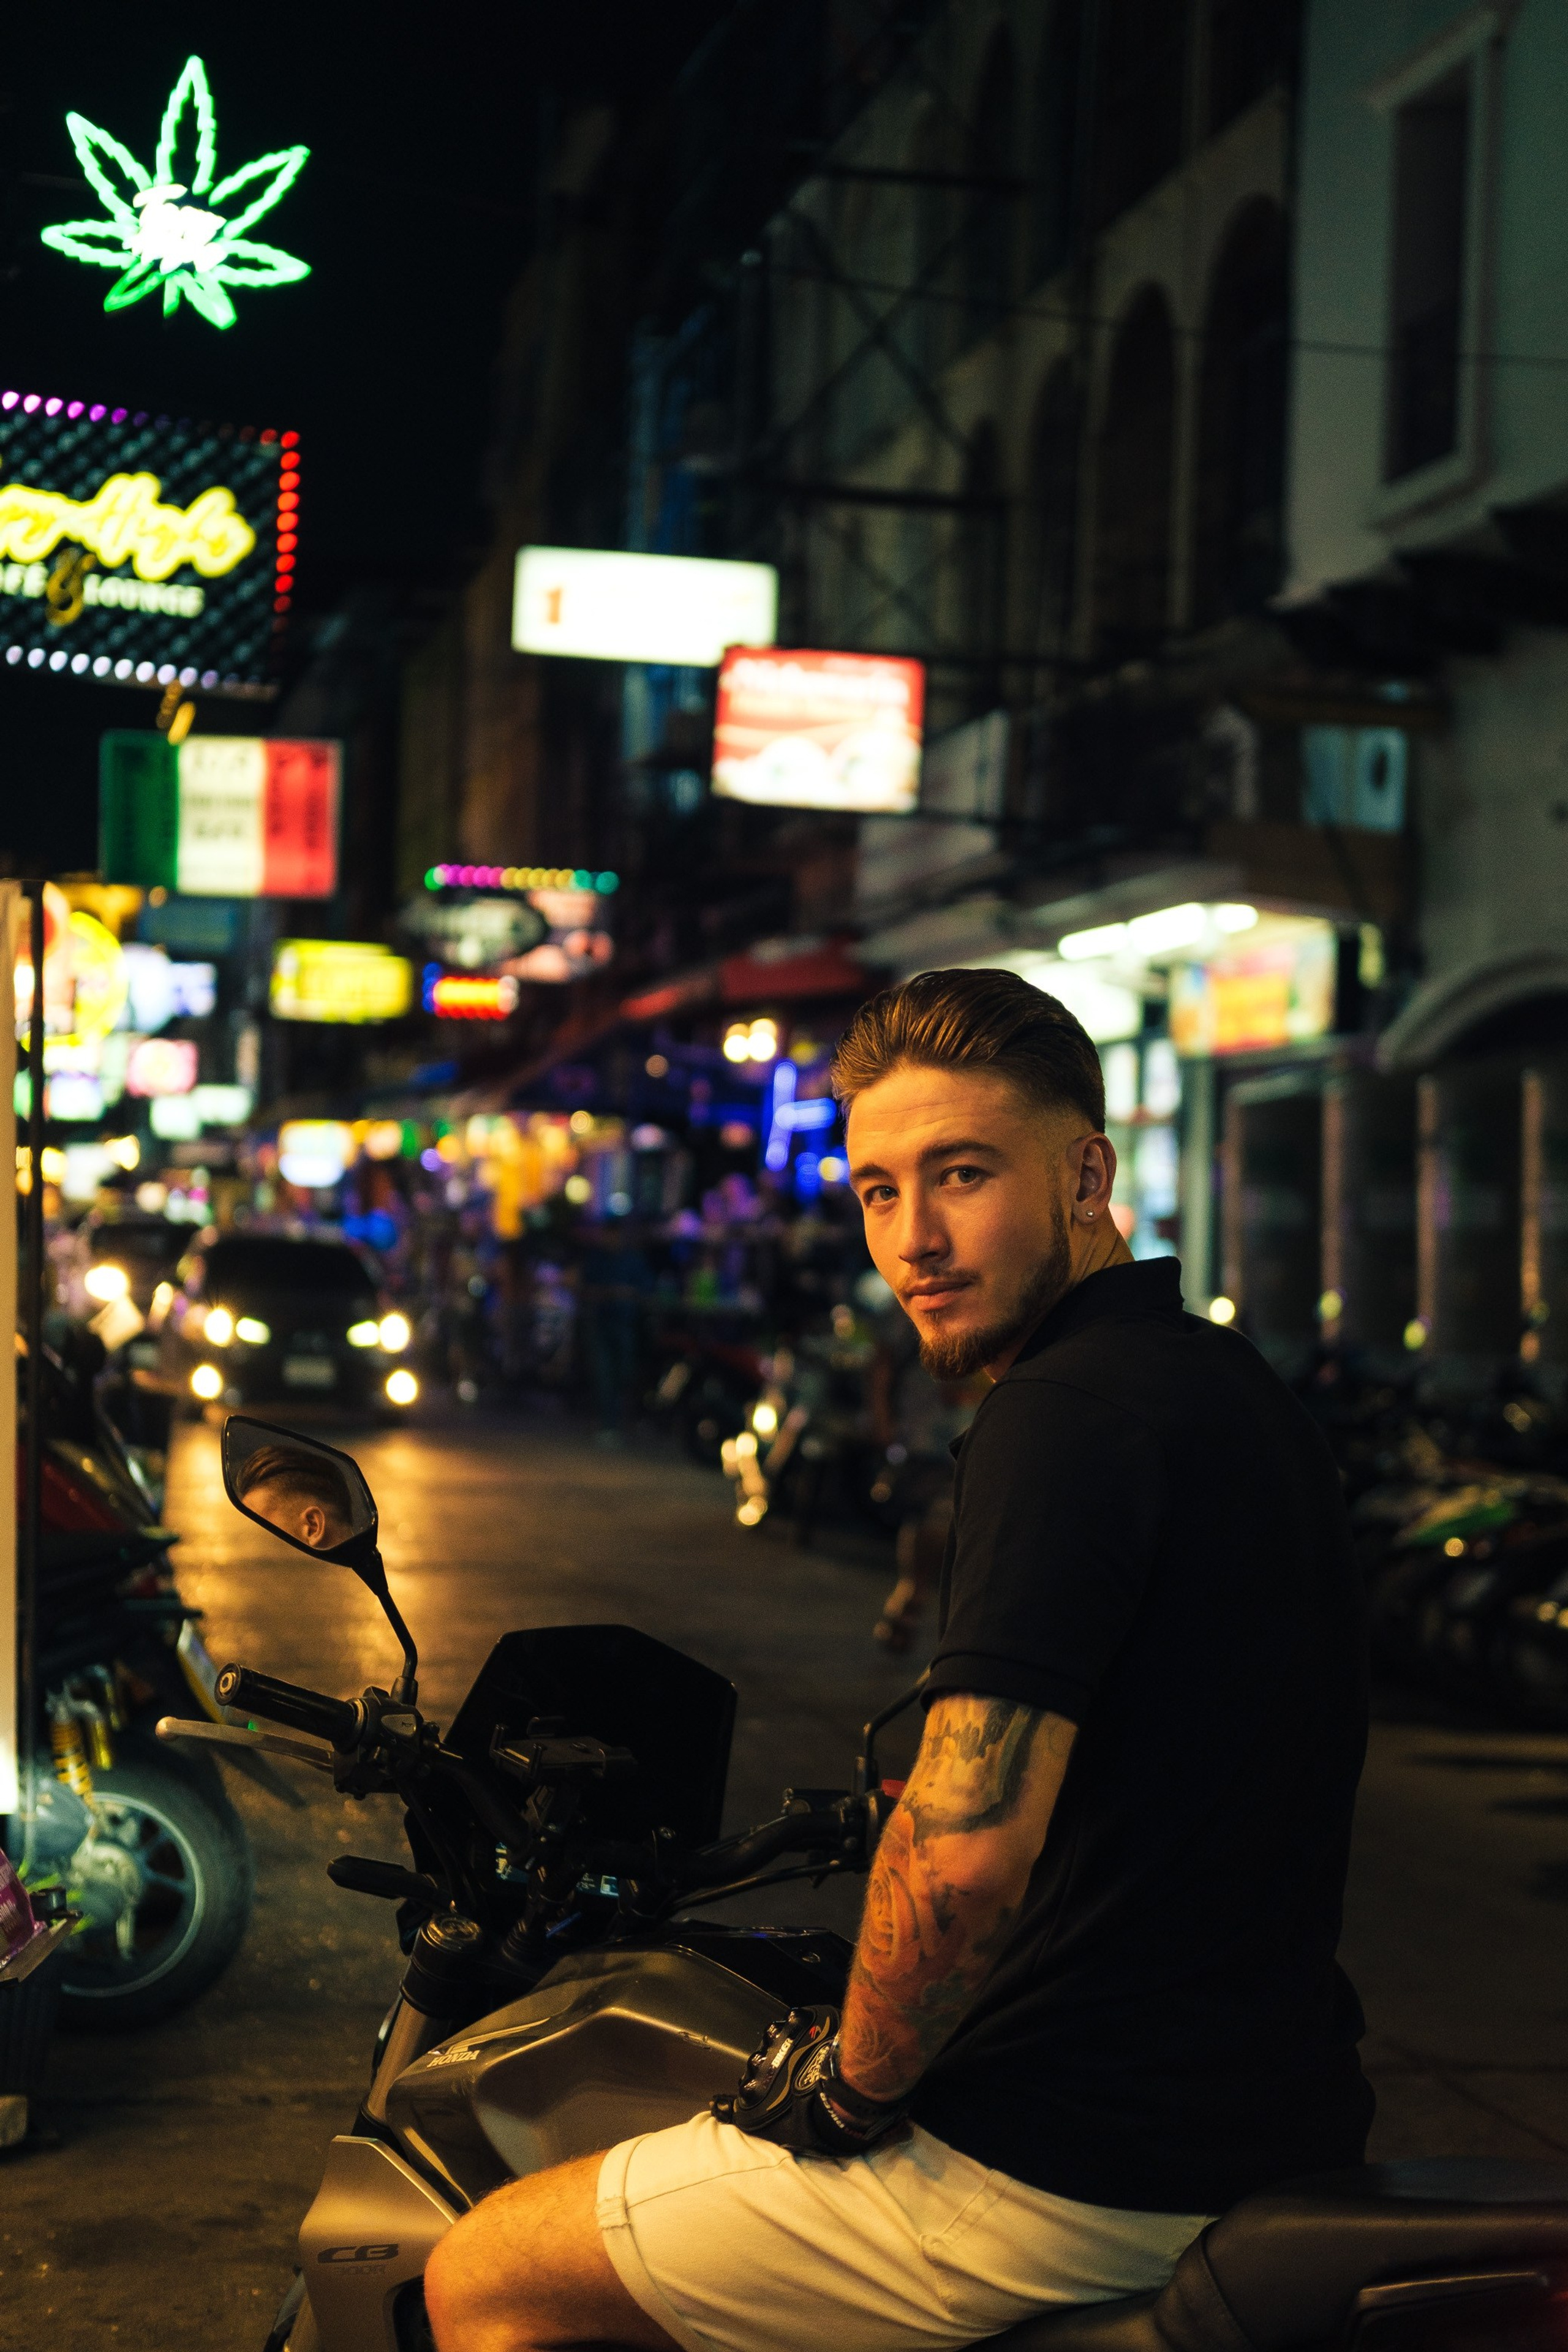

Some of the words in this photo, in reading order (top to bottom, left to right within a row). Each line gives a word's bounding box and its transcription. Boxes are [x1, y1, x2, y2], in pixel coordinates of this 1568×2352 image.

[82, 574, 205, 618] LOUNGE
[427, 2050, 480, 2068] HONDA
[317, 2243, 399, 2264] CB
